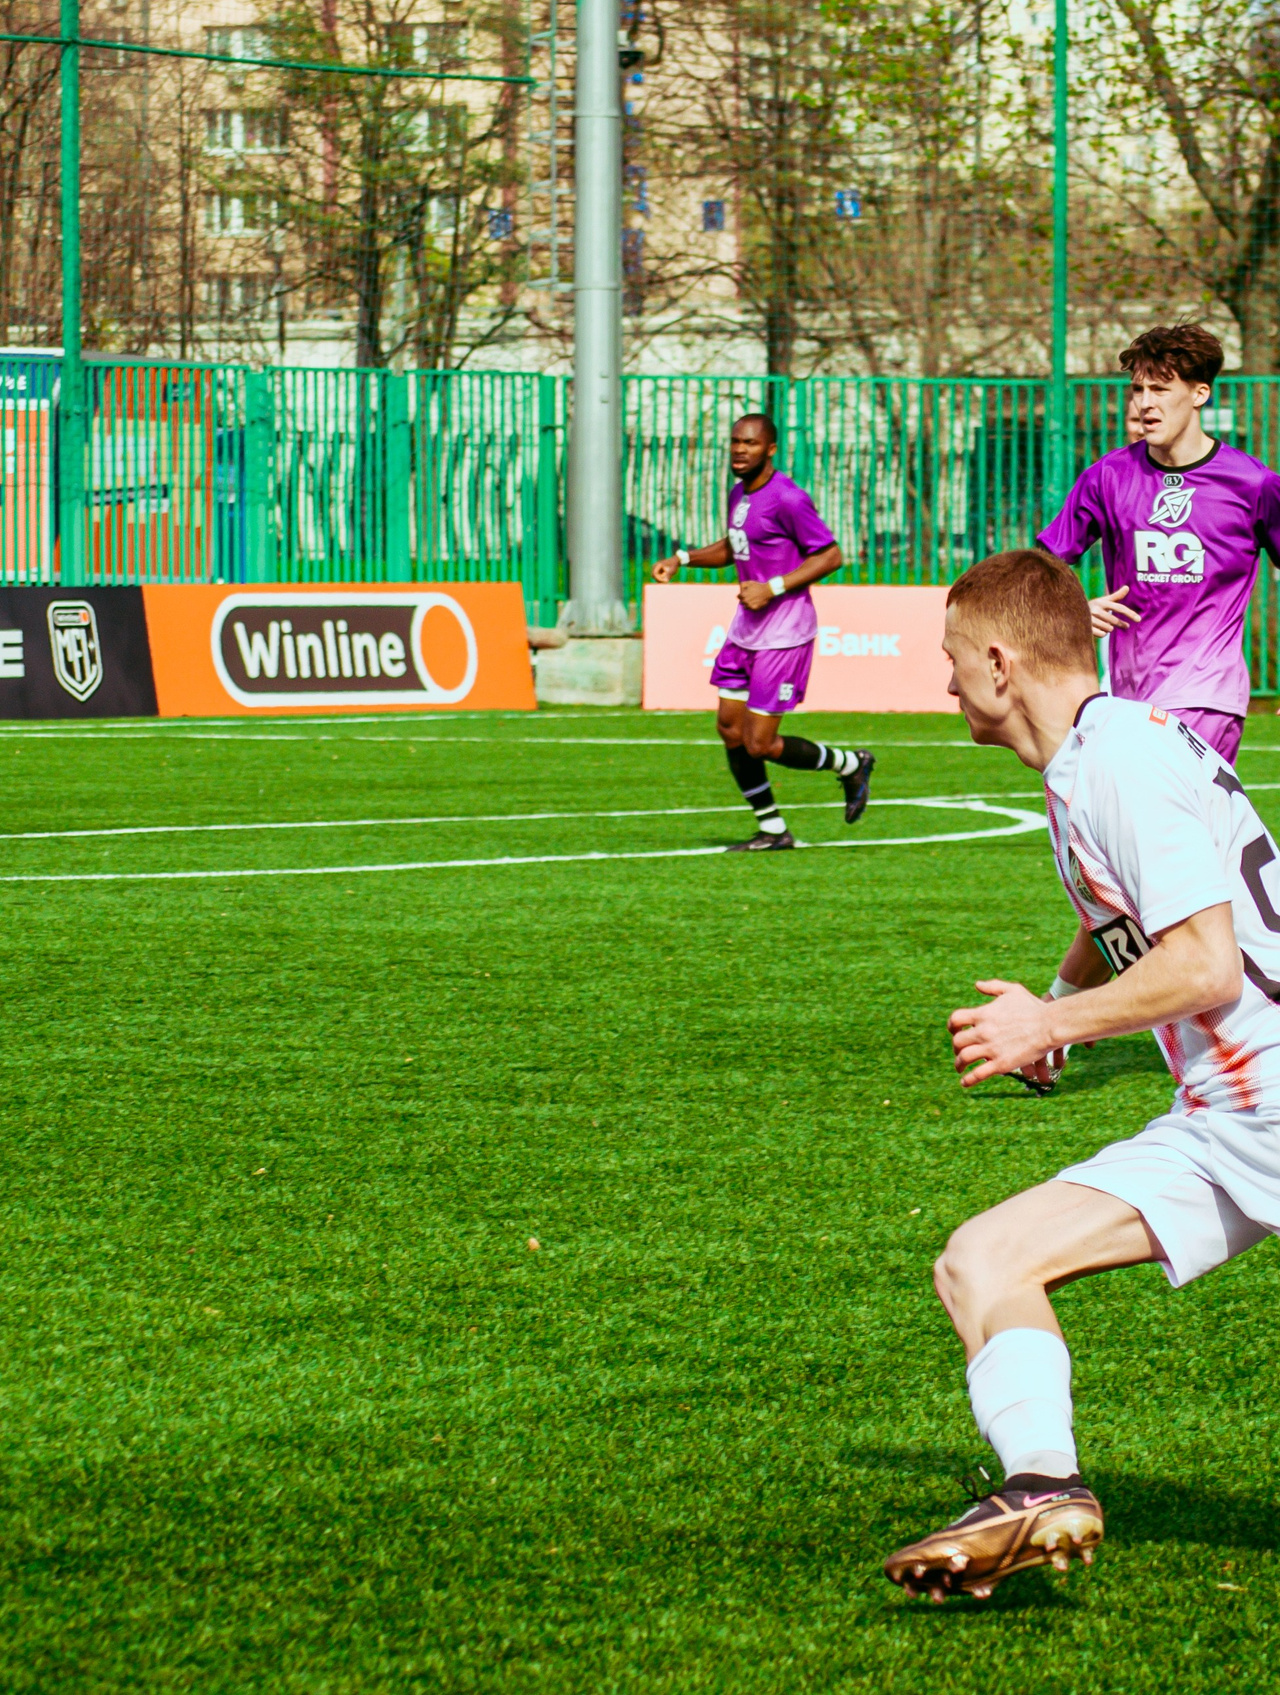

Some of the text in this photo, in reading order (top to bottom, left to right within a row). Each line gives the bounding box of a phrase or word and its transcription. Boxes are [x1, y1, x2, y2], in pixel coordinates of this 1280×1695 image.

[1134, 530, 1206, 574] RG
[1171, 574, 1204, 584] GROUP
[233, 619, 407, 679] Winline
[818, 626, 901, 657] Банк
